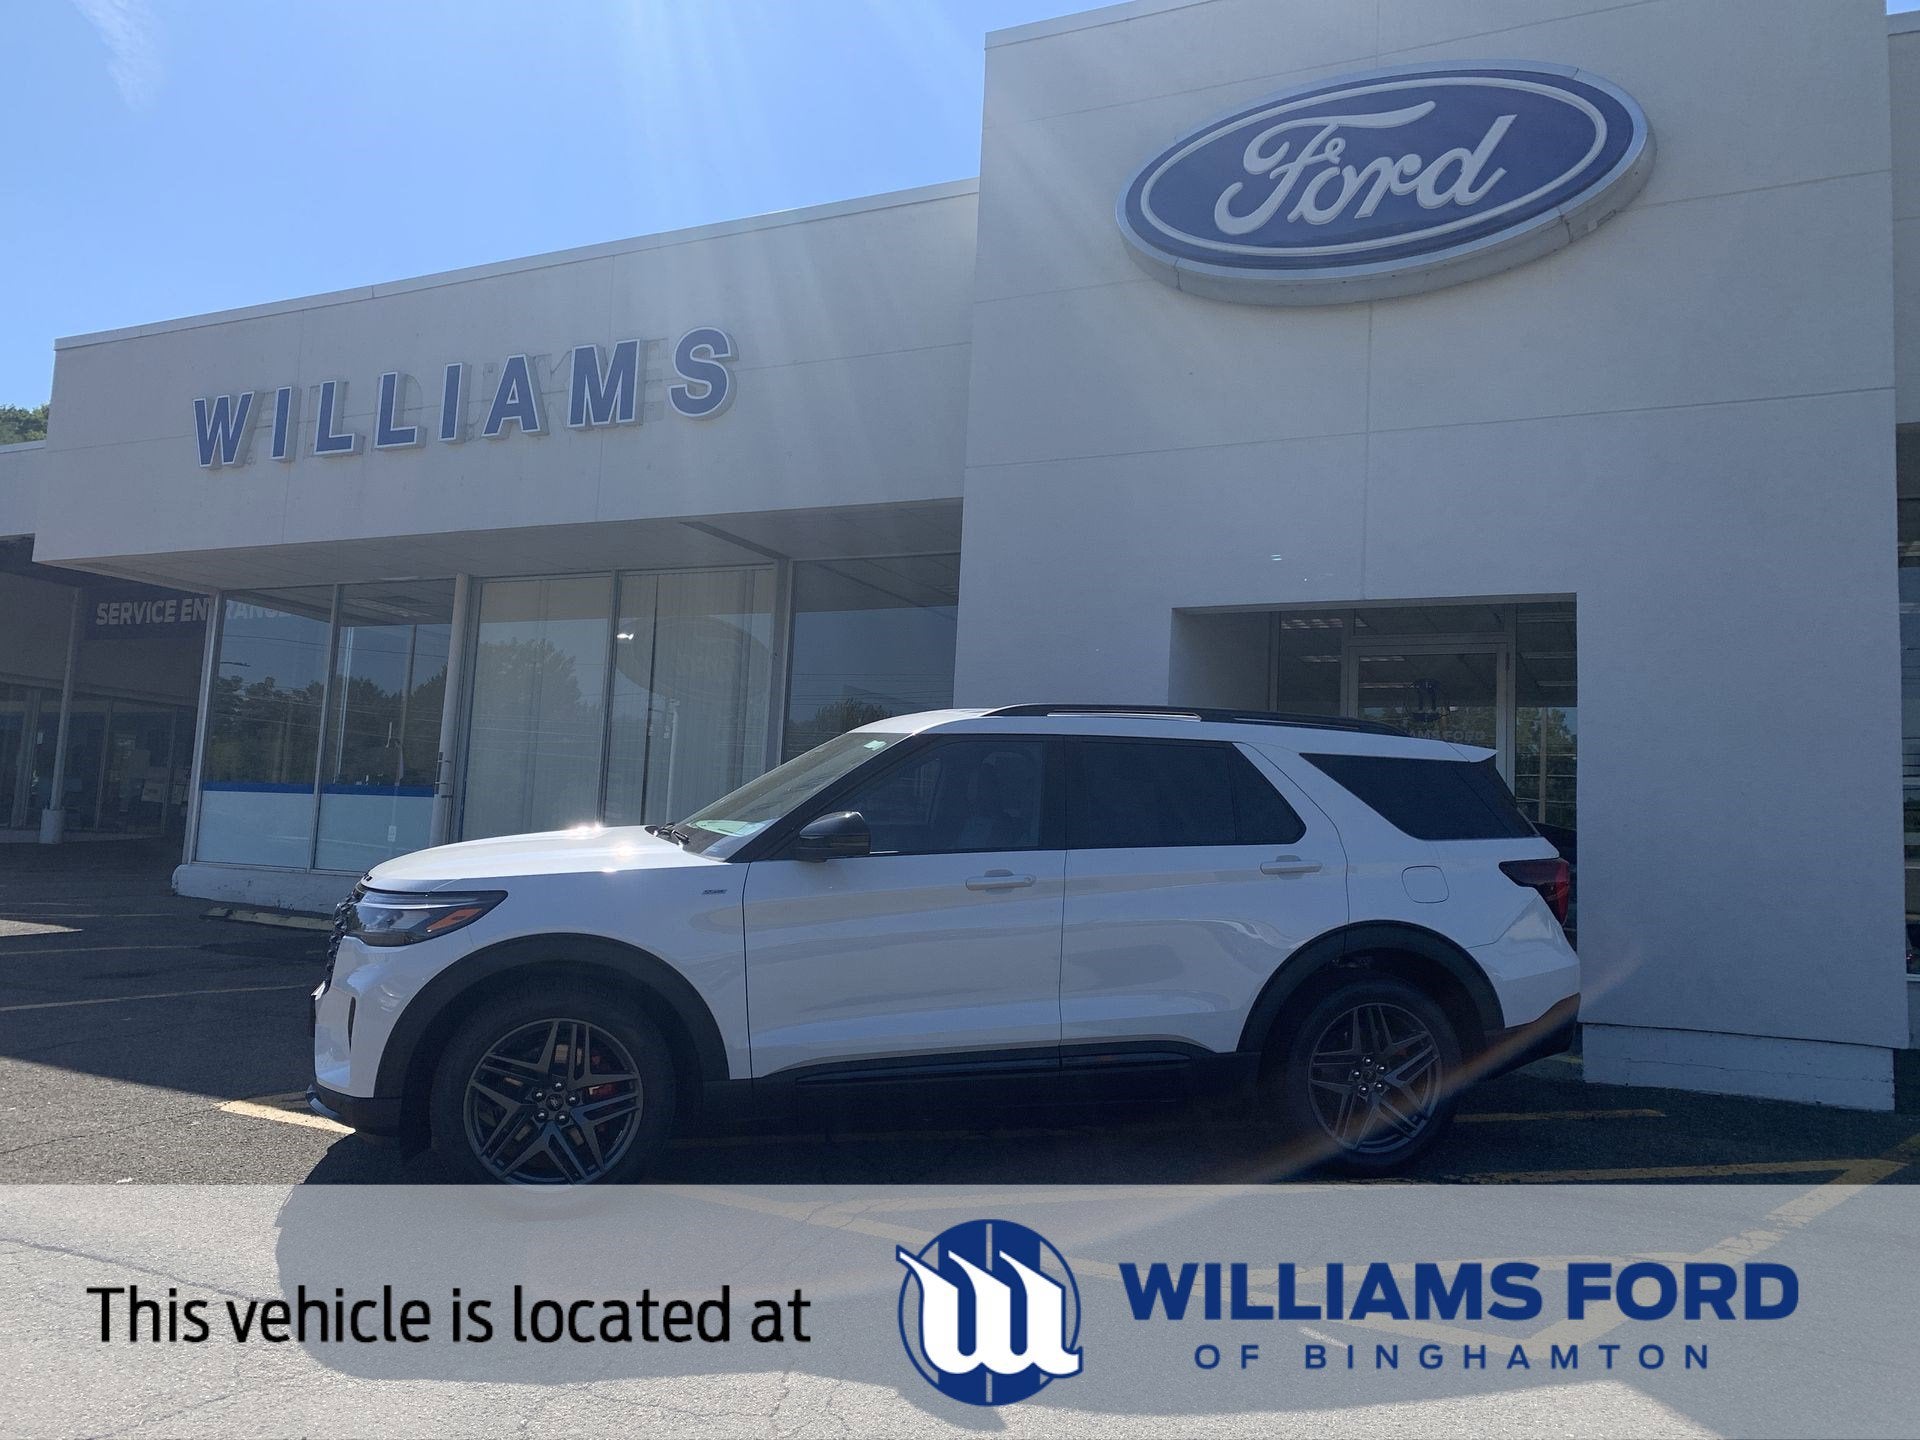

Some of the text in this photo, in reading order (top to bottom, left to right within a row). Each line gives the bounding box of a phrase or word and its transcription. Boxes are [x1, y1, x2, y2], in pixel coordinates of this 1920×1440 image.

[1213, 100, 1518, 236] Ford
[191, 325, 736, 469] WILLIAMS
[95, 599, 178, 626] SERVICE
